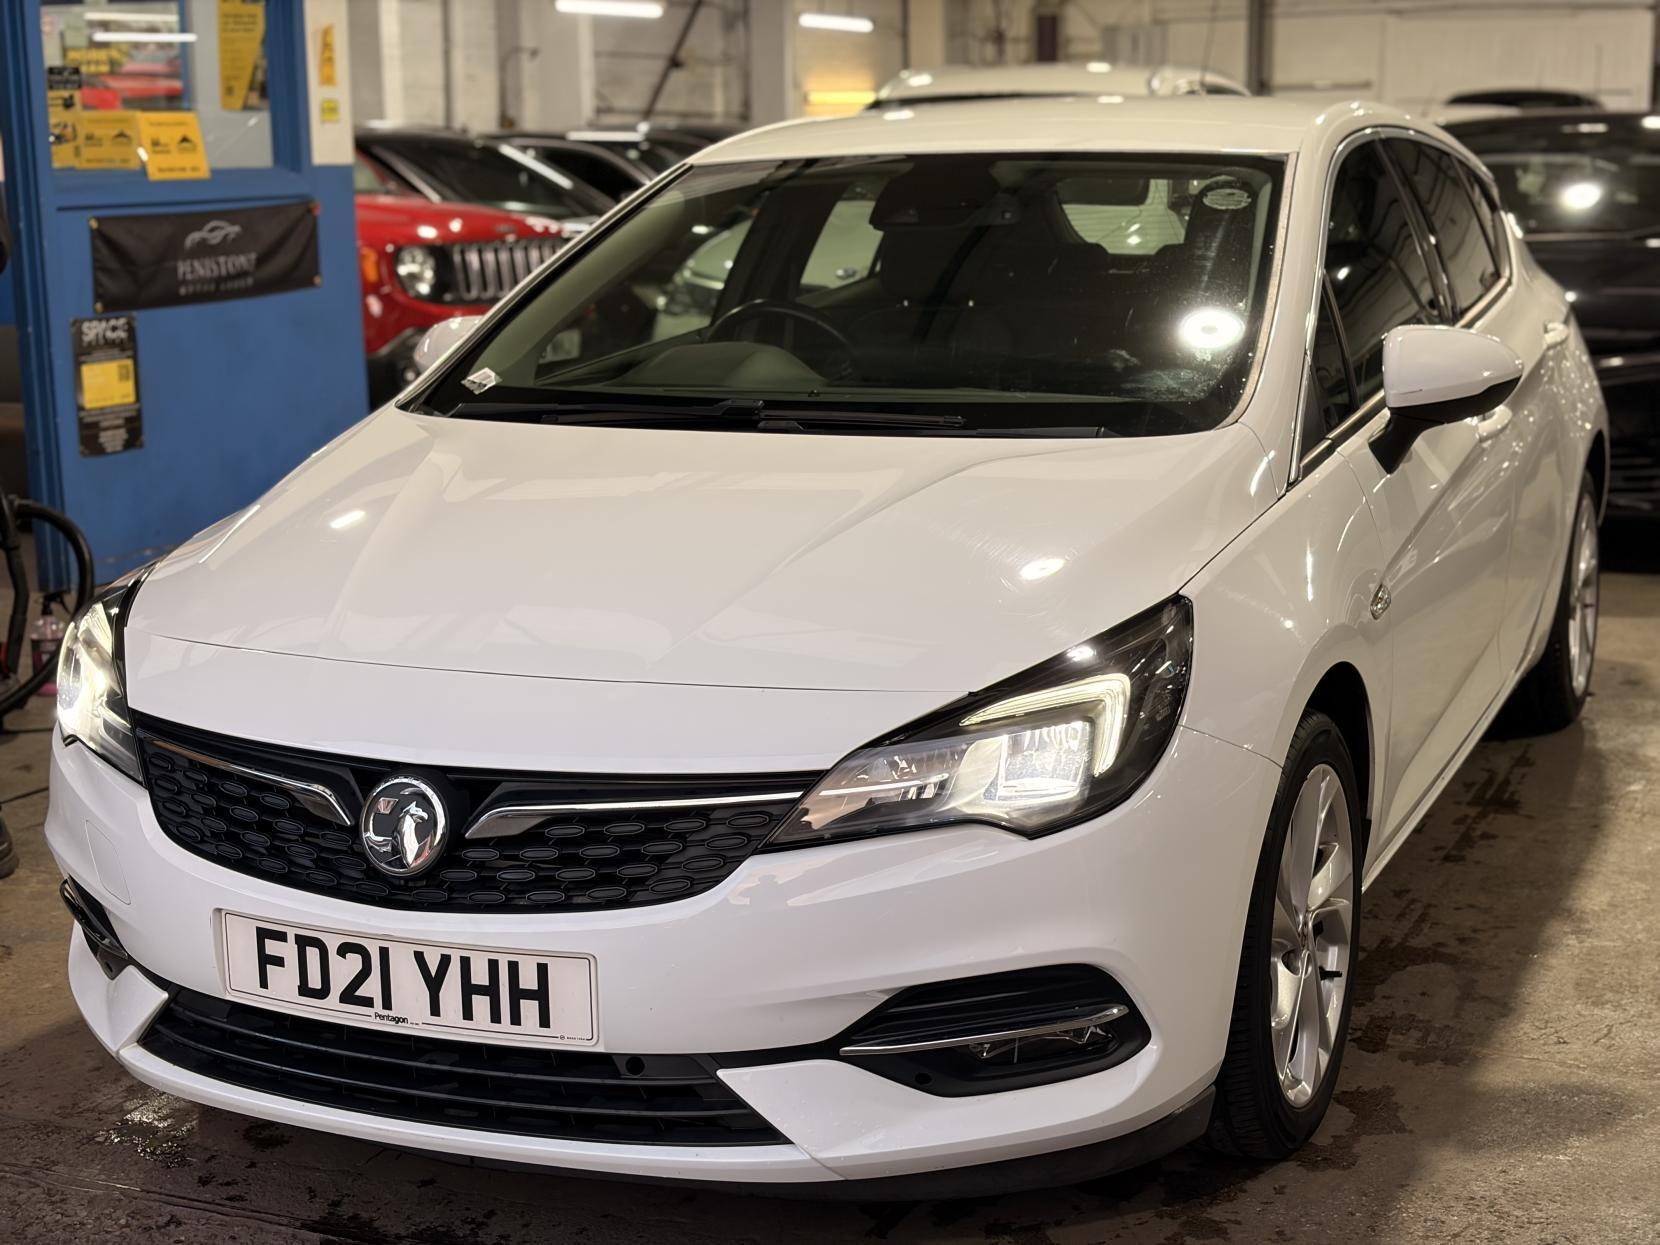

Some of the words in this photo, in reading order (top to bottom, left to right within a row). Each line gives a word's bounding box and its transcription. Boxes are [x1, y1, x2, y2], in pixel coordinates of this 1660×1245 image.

[255, 926, 393, 1011] FD21
[413, 950, 551, 1029] YHH
[374, 1011, 409, 1025] Pentagon
